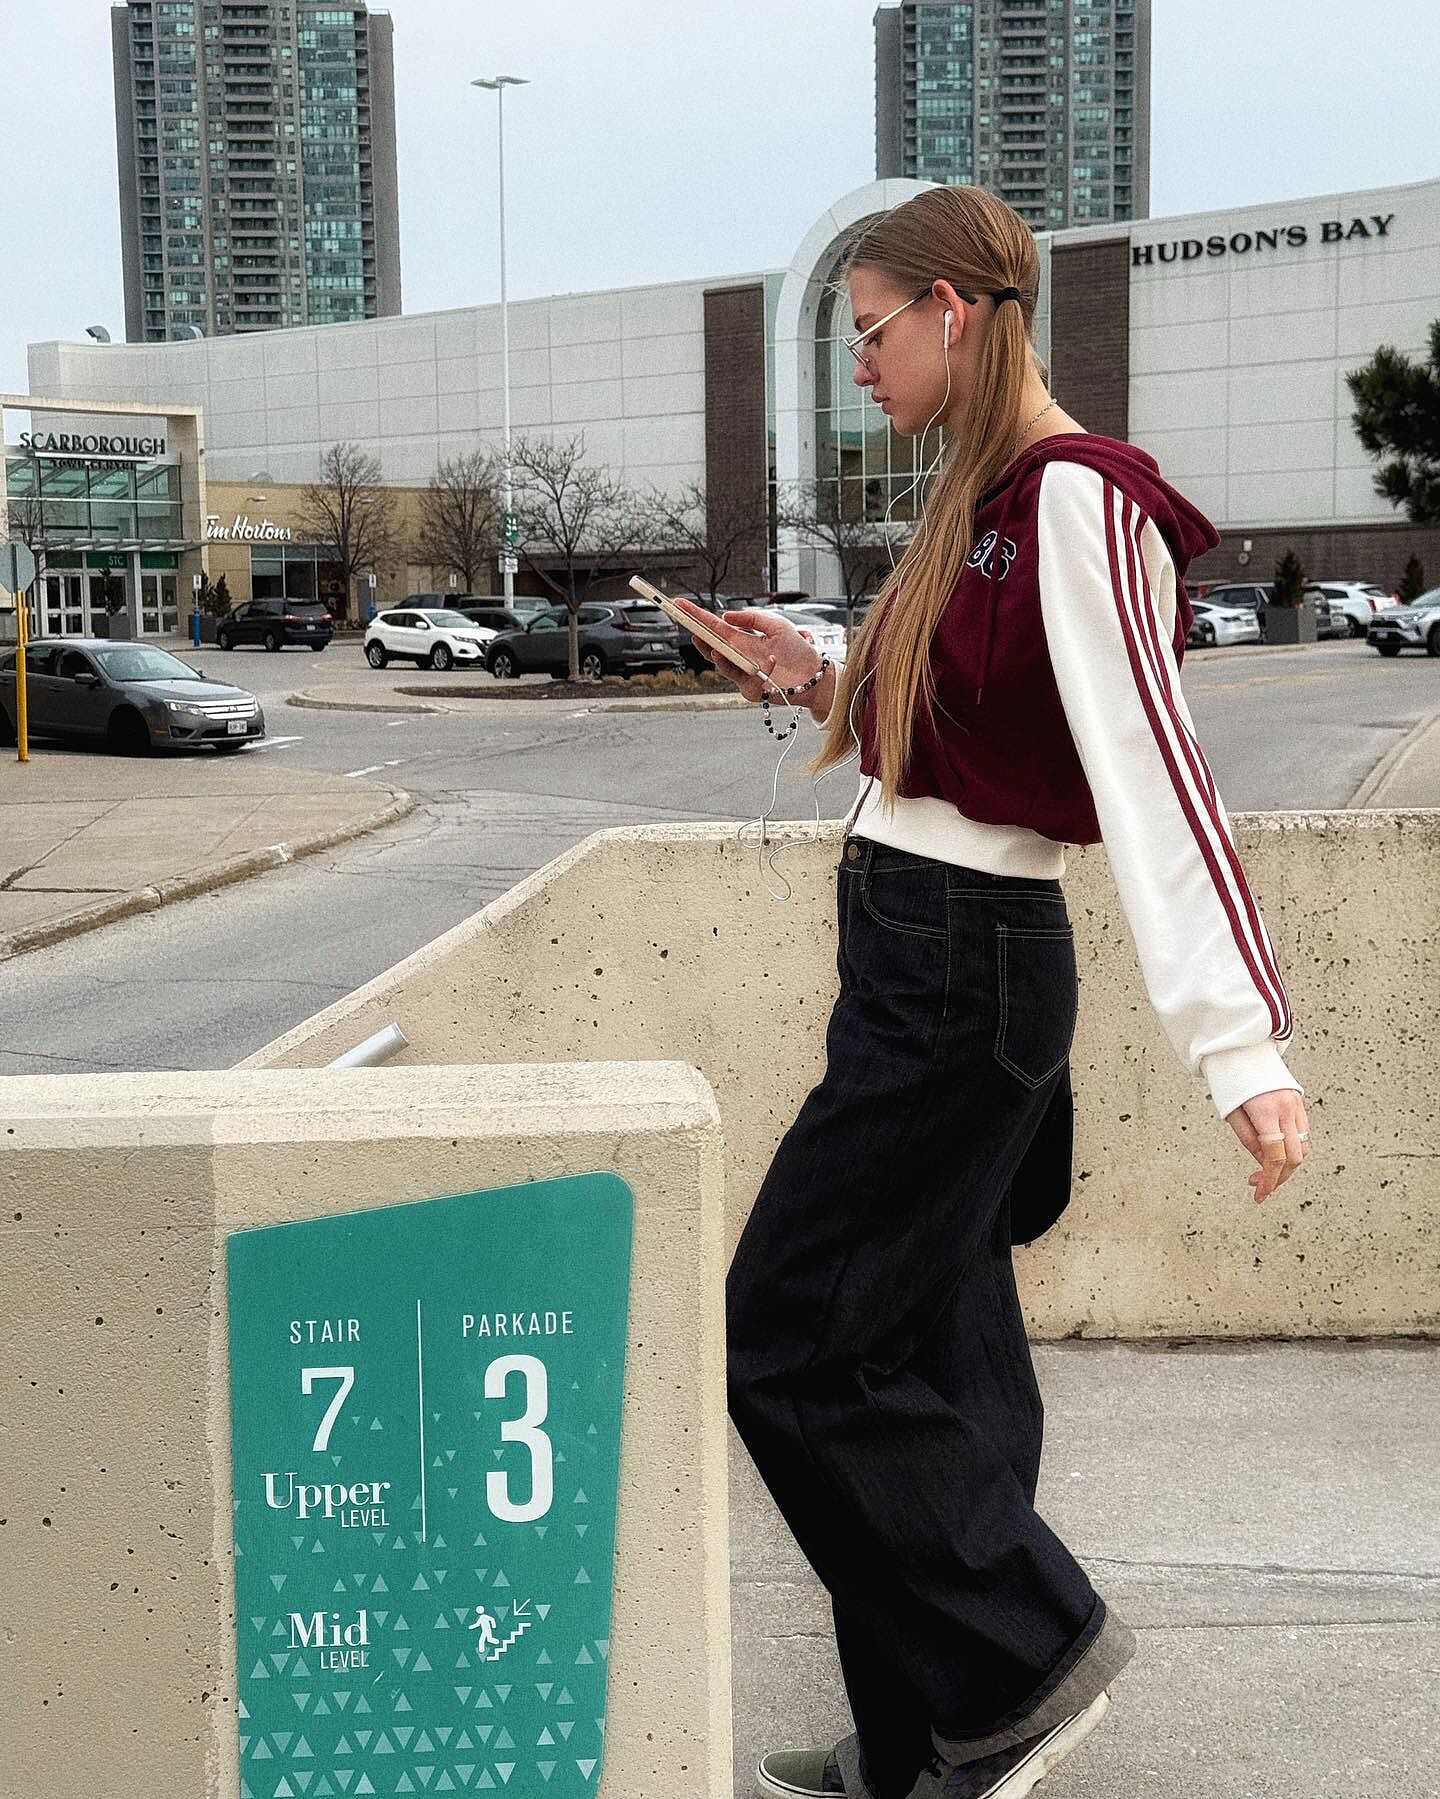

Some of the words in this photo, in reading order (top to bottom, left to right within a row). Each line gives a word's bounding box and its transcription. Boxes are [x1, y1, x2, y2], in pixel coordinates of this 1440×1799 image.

[1131, 225, 1308, 266] HUDSON'S
[1320, 214, 1395, 244] BAY
[19, 431, 166, 455] SCARBOROUGH
[231, 514, 291, 540] Hortons
[966, 530, 1017, 581] 86
[289, 1319, 360, 1344] STAIR
[462, 1311, 574, 1338] PARKADE
[301, 1366, 355, 1452] 7
[484, 1354, 554, 1523] 3
[260, 1472, 391, 1519] Upper
[341, 1508, 390, 1528] LEVEL
[286, 1609, 371, 1649] Mid
[320, 1650, 370, 1669] LEVEL
